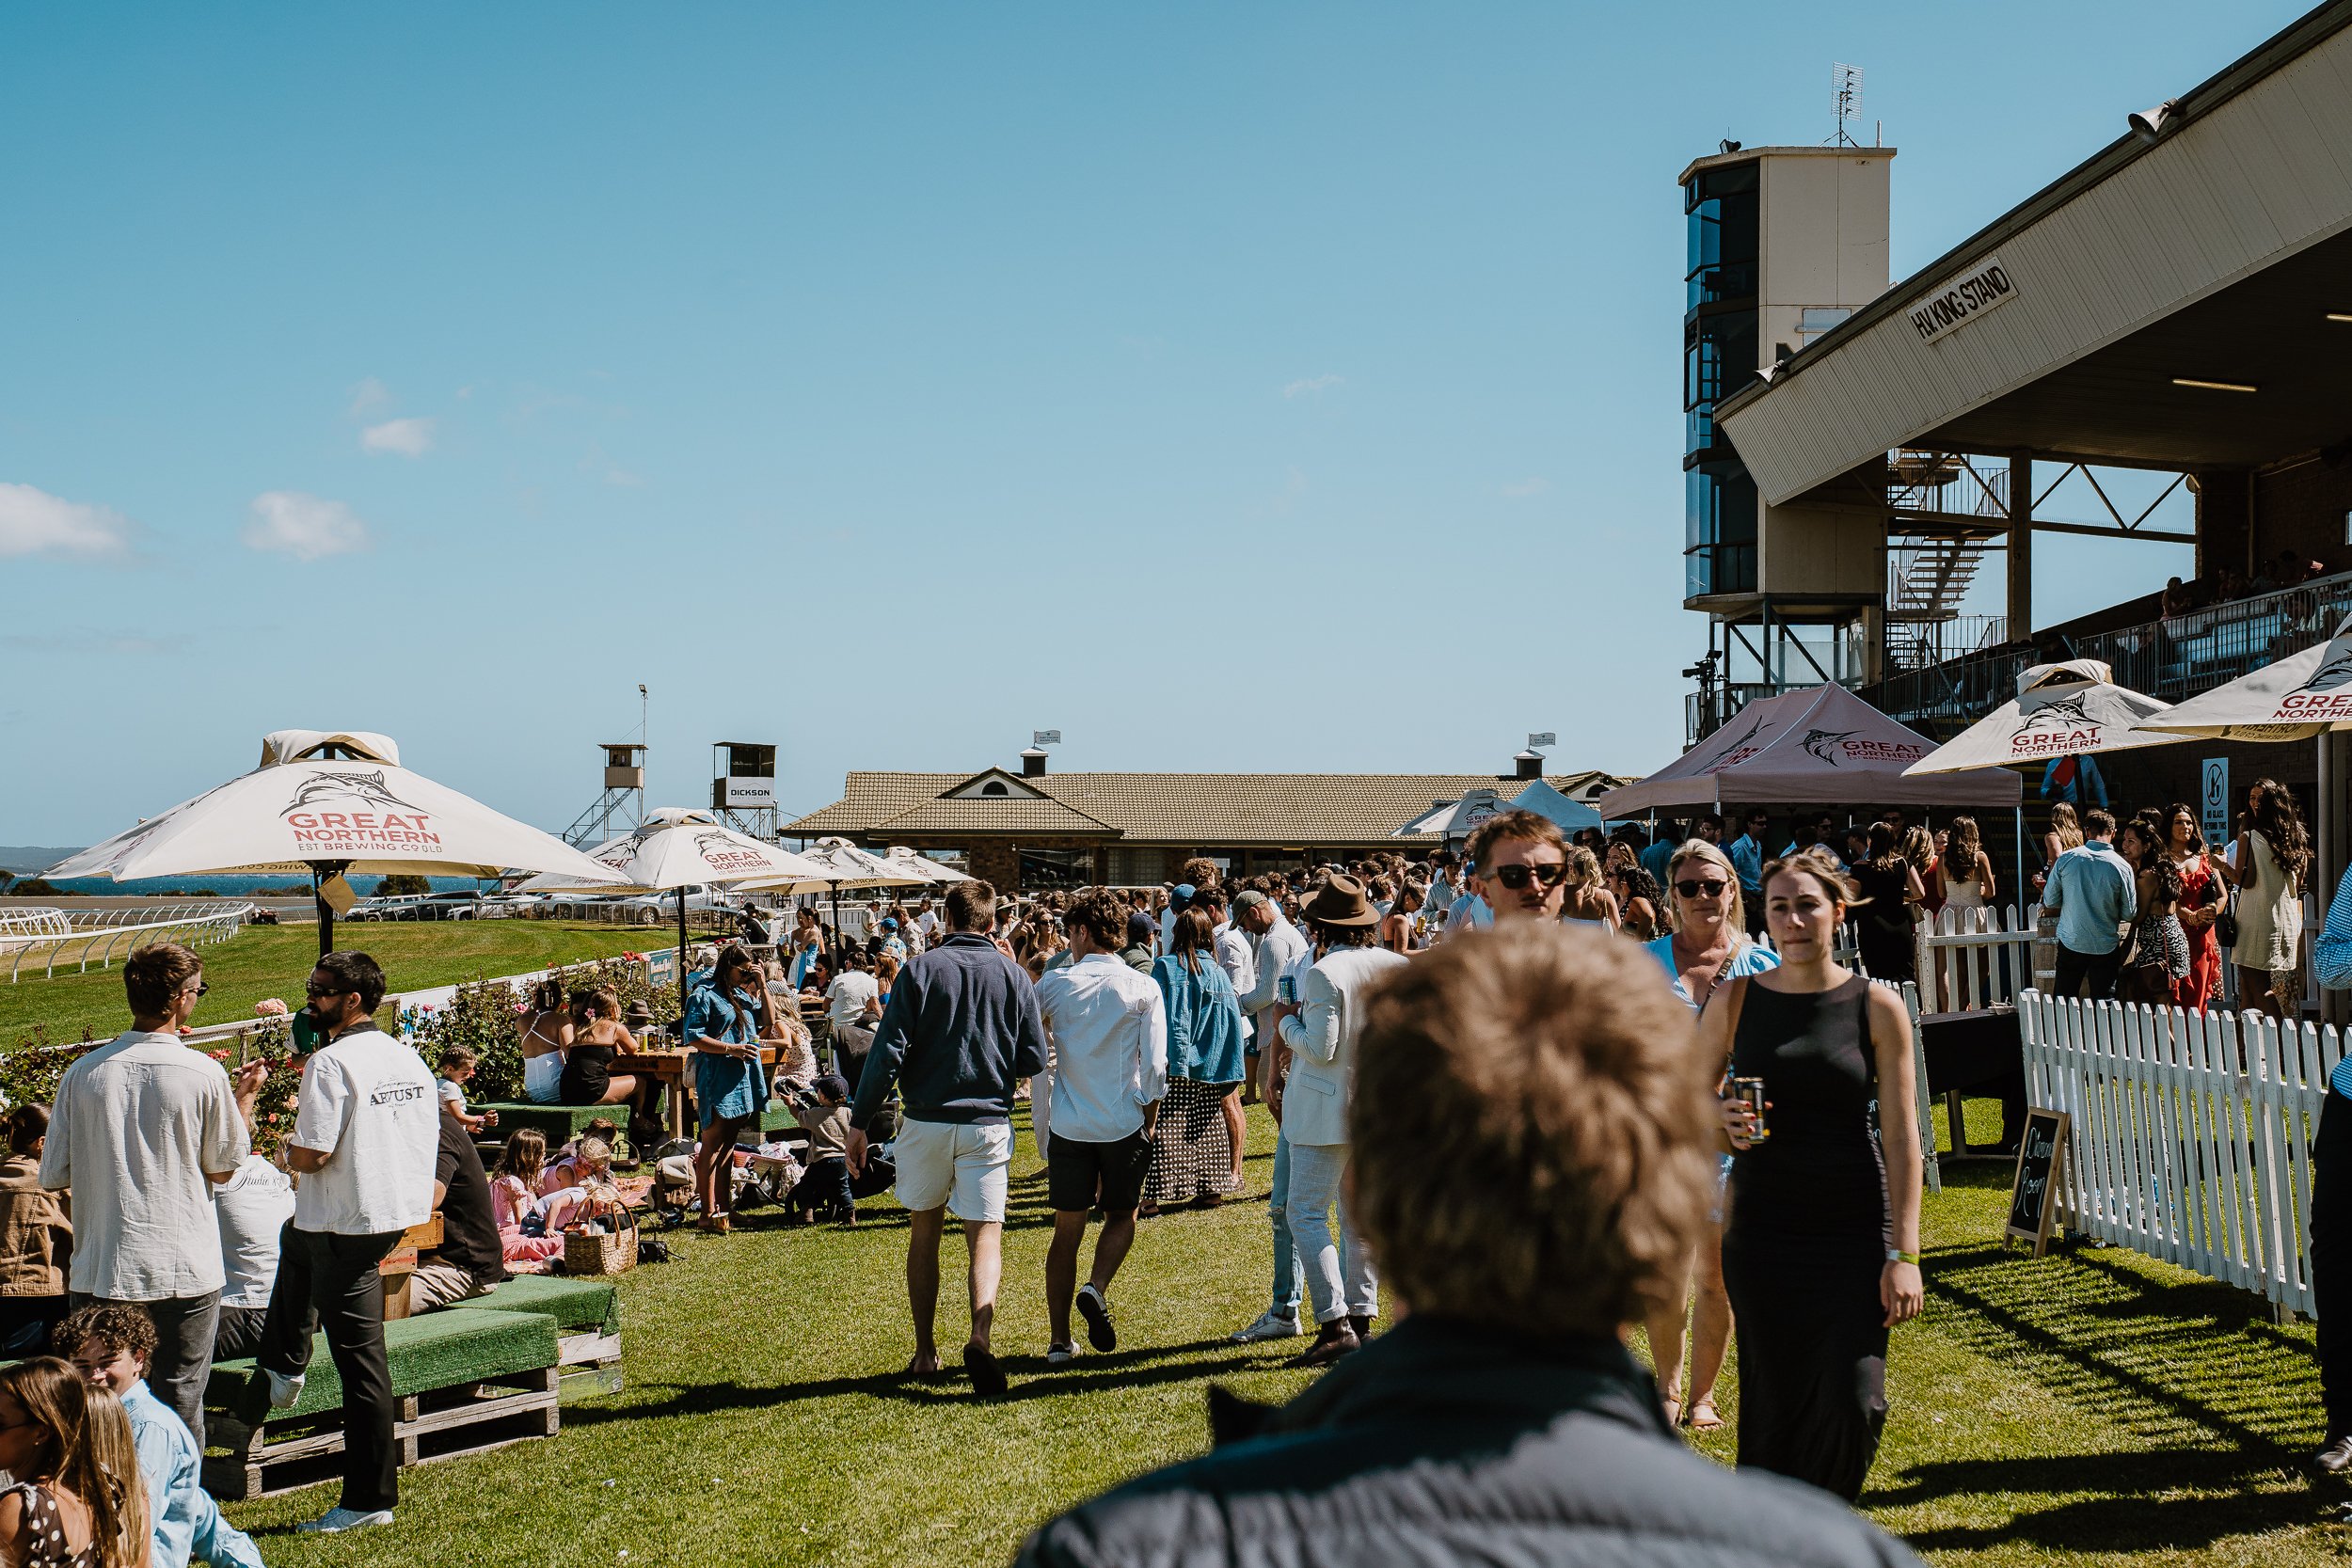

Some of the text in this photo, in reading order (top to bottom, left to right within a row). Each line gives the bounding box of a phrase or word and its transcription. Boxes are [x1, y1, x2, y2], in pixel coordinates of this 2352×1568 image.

[1929, 291, 1968, 329] KING
[1959, 265, 2010, 310] STAND
[2281, 694, 2352, 708] GRE
[2272, 708, 2352, 719] NORTHE
[2012, 726, 2101, 746] GREAT
[1842, 740, 1921, 753] GREAT
[2011, 738, 2101, 753] NORTHERN
[288, 813, 429, 831] GREAT
[294, 830, 440, 844] NORTHERN
[324, 843, 396, 851] BREWING
[705, 851, 762, 863] GREAT
[712, 860, 771, 870] NORTHERN
